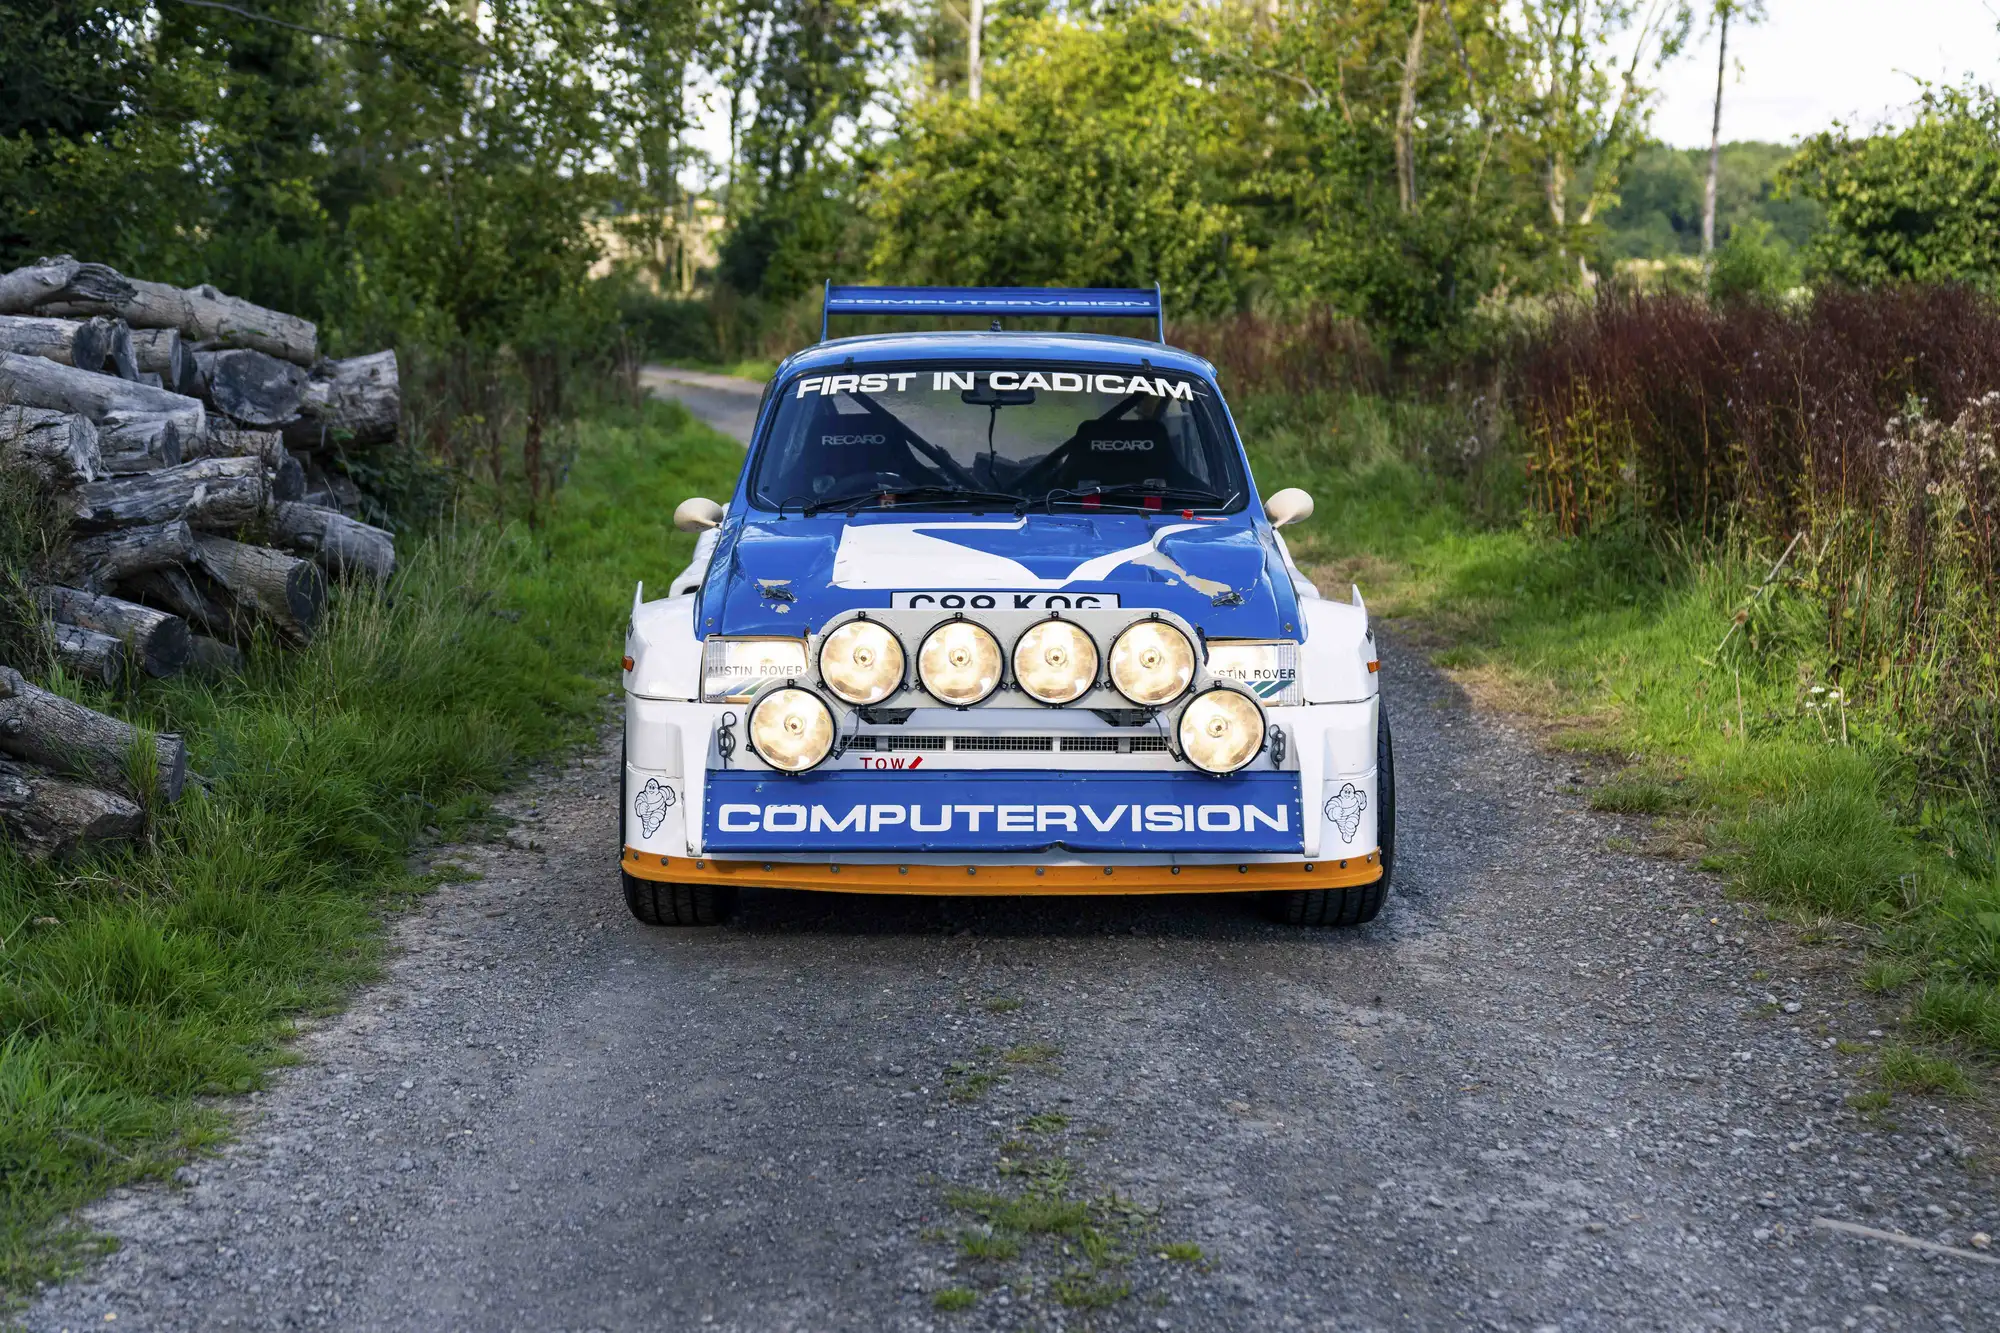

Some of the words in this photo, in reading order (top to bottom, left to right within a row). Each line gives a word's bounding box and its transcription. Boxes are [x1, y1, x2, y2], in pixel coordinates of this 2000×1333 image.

[830, 298, 1150, 308] COMPUTERVISION
[796, 373, 916, 399] FIRST
[933, 371, 975, 391] IN
[821, 434, 886, 446] RECARO
[1091, 440, 1154, 451] RECARO
[707, 665, 753, 676] AUSTIN
[760, 665, 803, 676] ROVER
[1214, 668, 1247, 680] STIN
[1254, 668, 1296, 679] ROVER
[859, 757, 905, 769] TOW
[718, 803, 1289, 833] COMPUTERVISION
